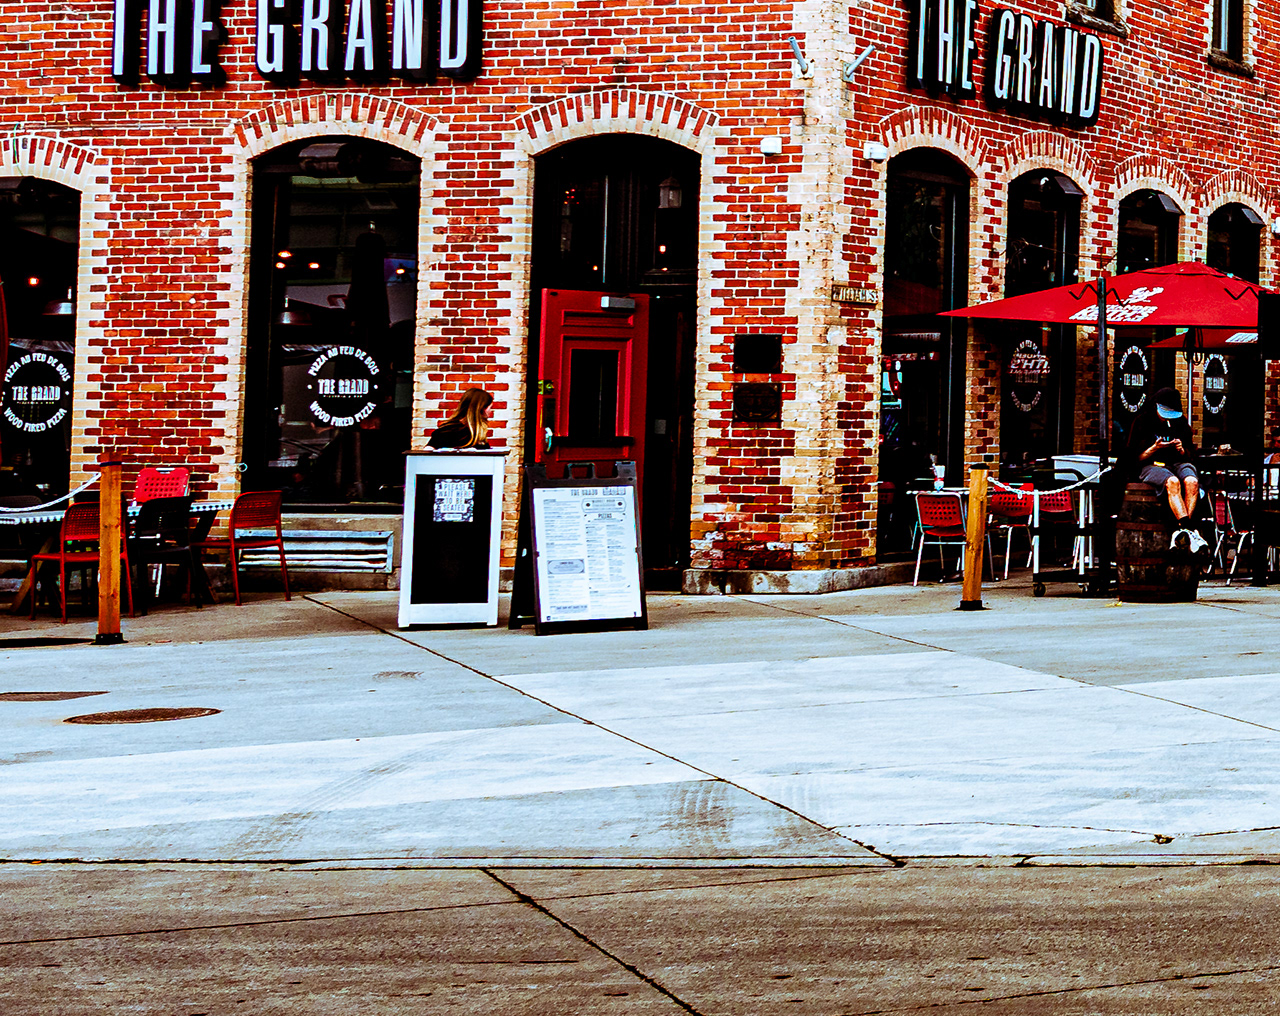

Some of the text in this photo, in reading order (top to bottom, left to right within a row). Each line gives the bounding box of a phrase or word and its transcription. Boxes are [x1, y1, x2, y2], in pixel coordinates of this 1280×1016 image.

[994, 9, 1101, 119] GRAND
[32, 352, 47, 363] FEU
[46, 355, 59, 367] DE
[55, 363, 71, 382] BOIS
[307, 354, 329, 376] PIZZA
[339, 346, 355, 356] FEU
[355, 348, 367, 361] DE
[364, 355, 380, 376] BOIS
[12, 386, 60, 401] THE GRAND
[318, 378, 369, 394] THE GRAND
[4, 407, 67, 432] WOOD FIRED PIZZA
[309, 401, 377, 427] WOOD FIRED PIZZA
